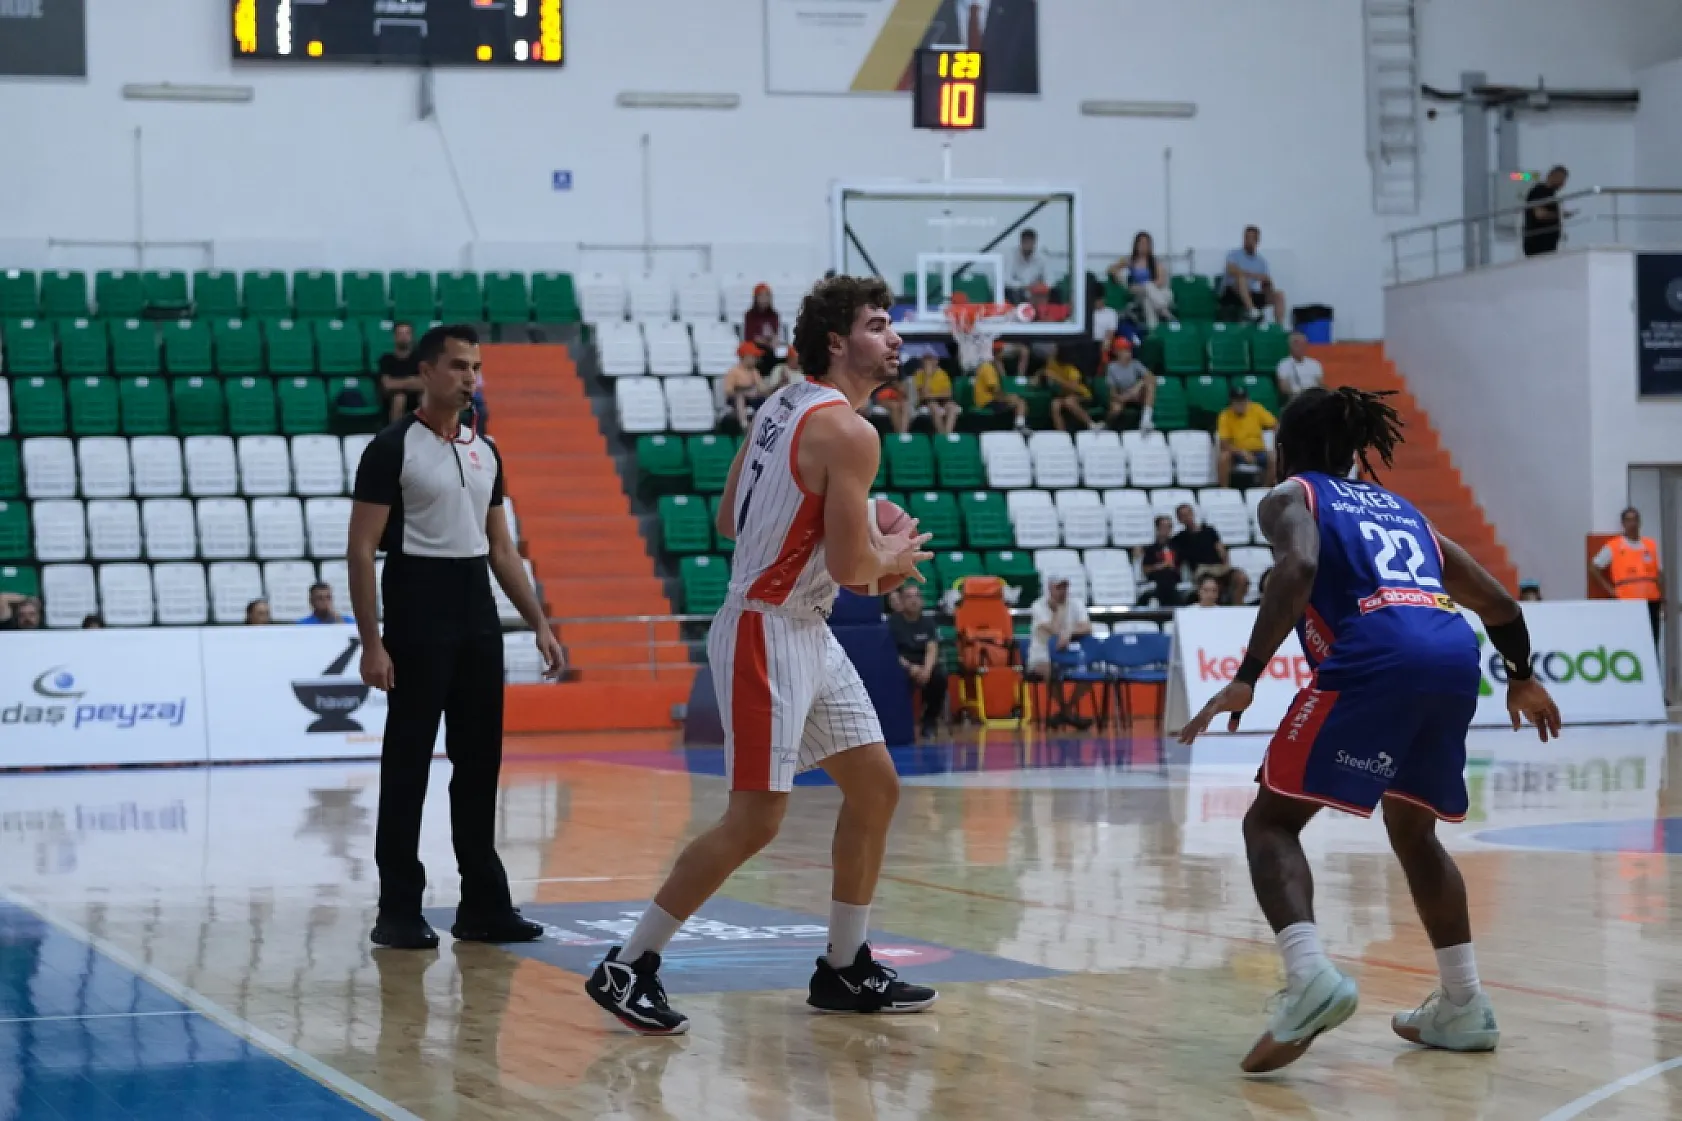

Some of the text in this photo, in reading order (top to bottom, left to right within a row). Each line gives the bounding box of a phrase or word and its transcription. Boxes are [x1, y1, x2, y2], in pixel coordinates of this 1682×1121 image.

[941, 83, 976, 127] 10
[1359, 521, 1441, 587] 22
[1197, 646, 1312, 688] keap
[73, 698, 187, 731] peyzaj
